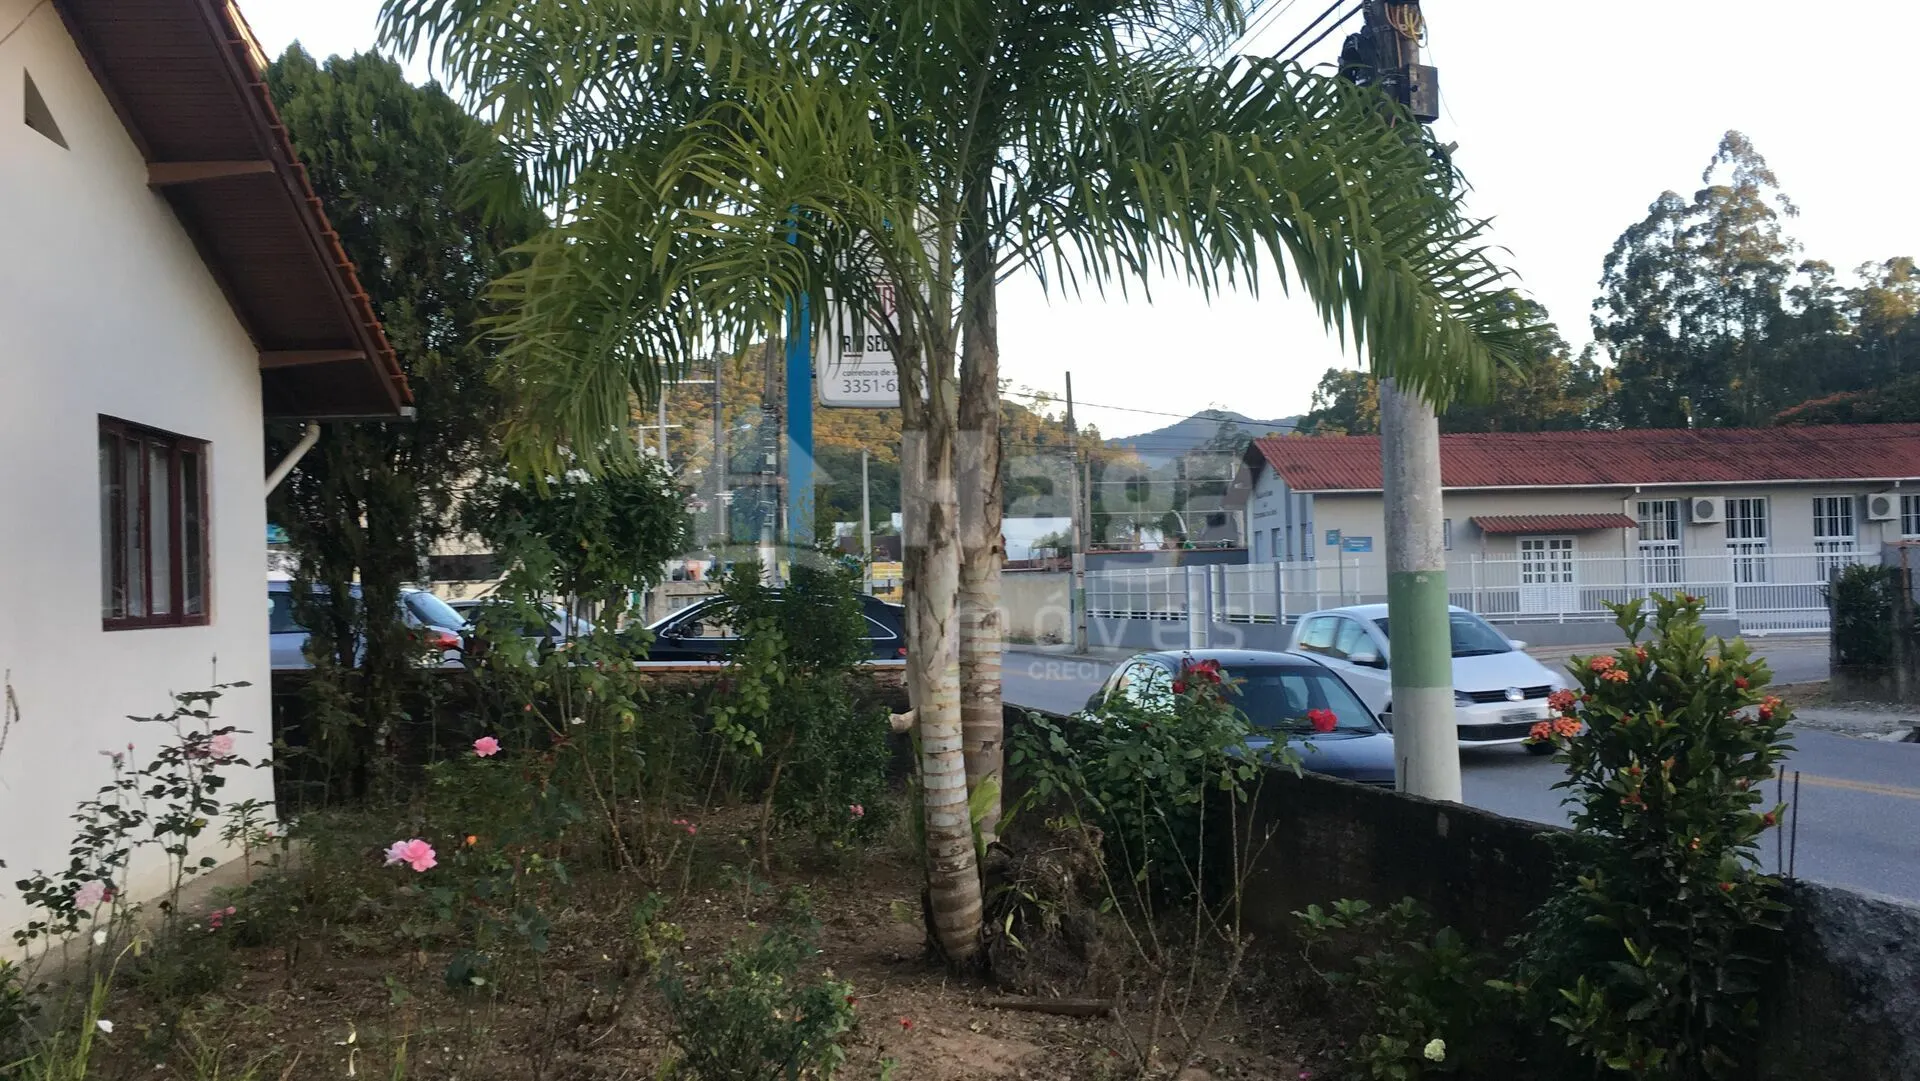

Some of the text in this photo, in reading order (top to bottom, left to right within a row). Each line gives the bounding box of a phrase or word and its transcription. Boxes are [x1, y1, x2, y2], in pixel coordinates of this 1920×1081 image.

[842, 369, 878, 377] corretora
[880, 368, 891, 377] de
[842, 379, 899, 394] 3351-6
